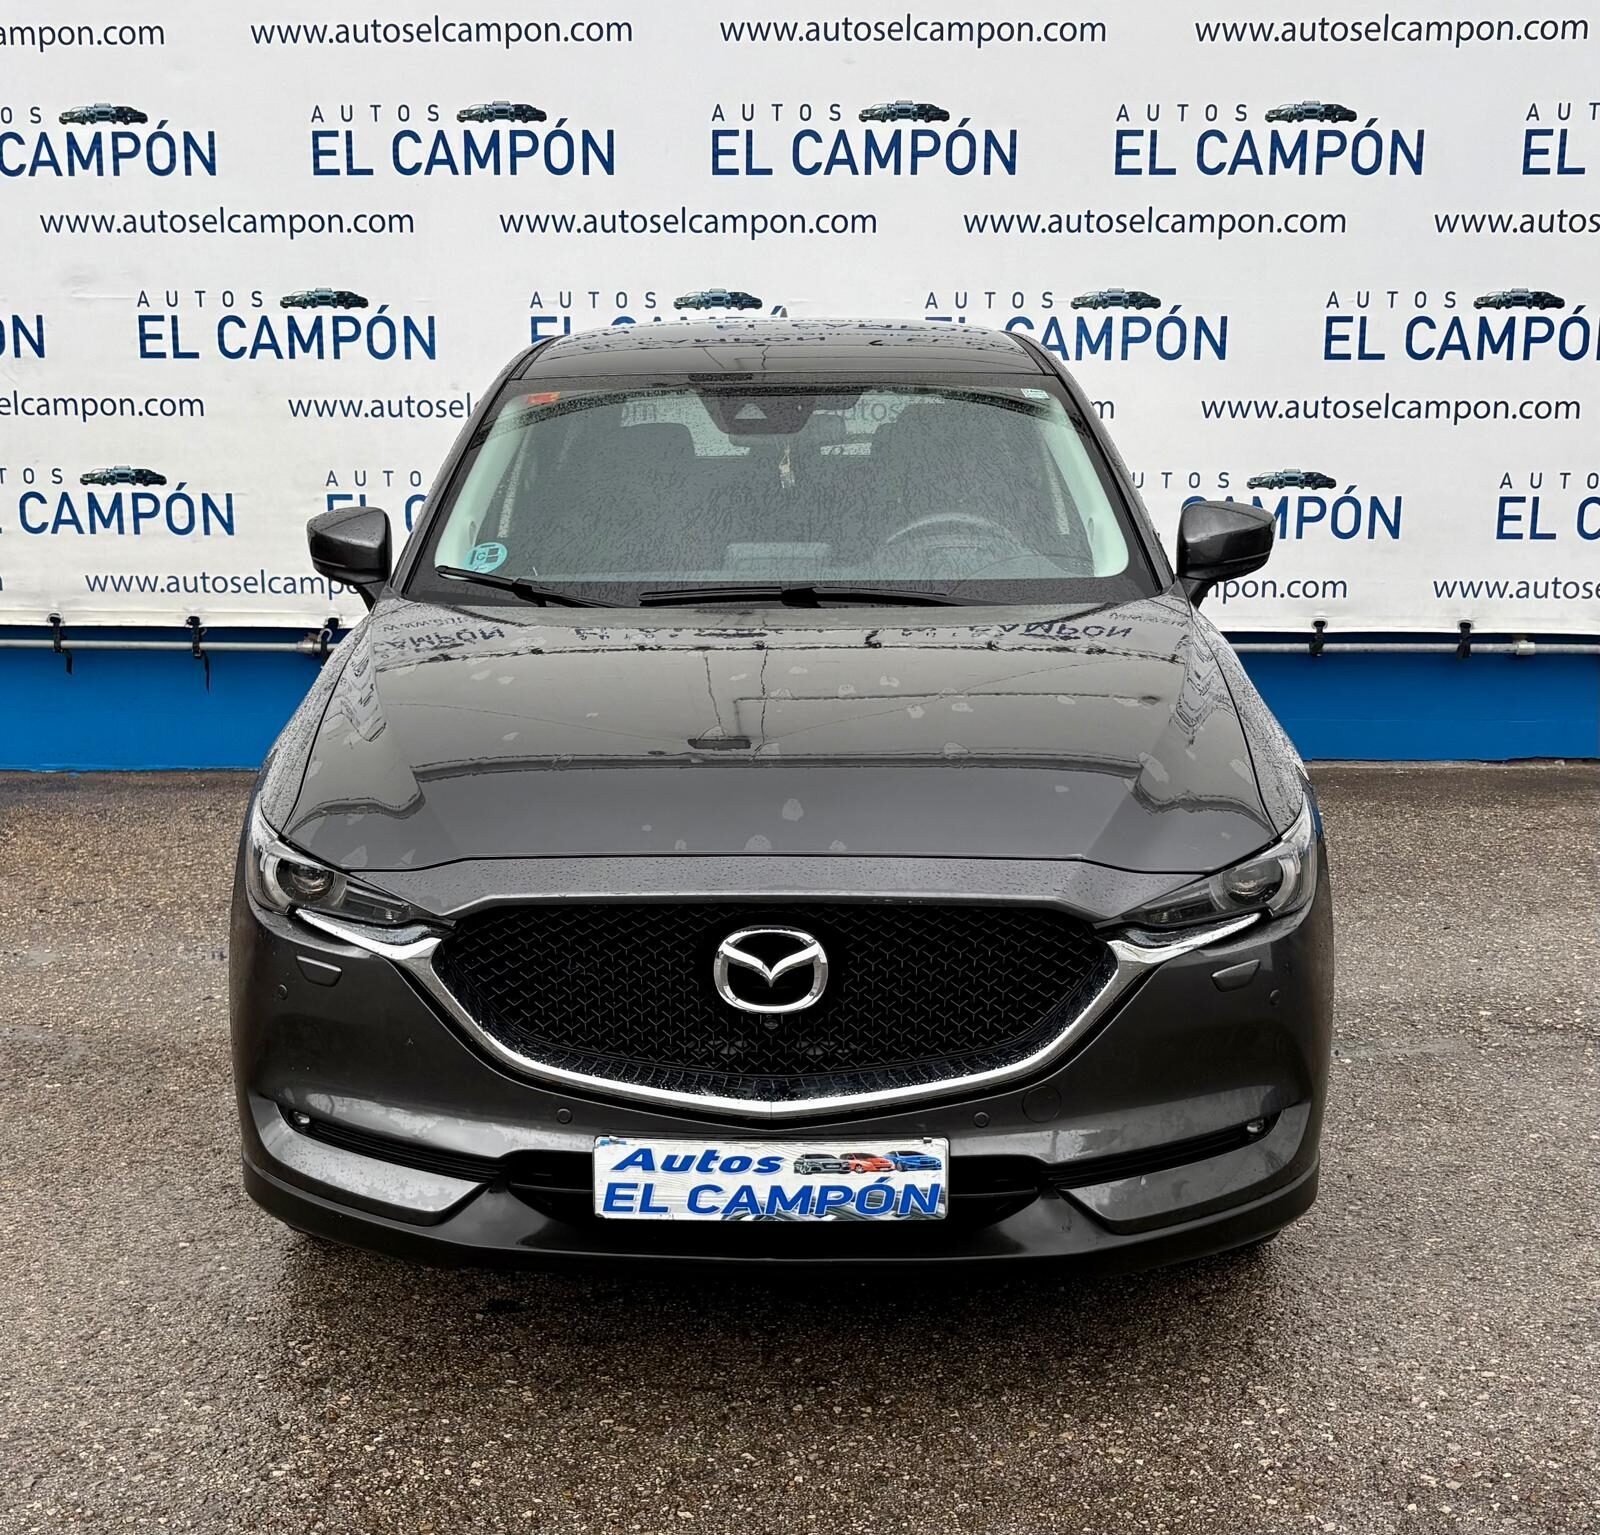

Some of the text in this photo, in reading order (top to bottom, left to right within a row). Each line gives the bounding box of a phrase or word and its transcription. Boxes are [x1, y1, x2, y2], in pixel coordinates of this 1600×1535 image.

[250, 14, 632, 50] www.autoselcampon.com
[719, 13, 1106, 49] www.autoselcampon.com
[1195, 13, 1589, 49] www.autoselcampon.com
[310, 103, 440, 123] AUTOS
[711, 103, 841, 122] AUTOS
[1115, 103, 1247, 122] AUTOS
[0, 118, 217, 178] CAMPÓN
[311, 116, 615, 176] EL CAMPÓN
[711, 116, 1018, 176] EL CAMPÓN
[1114, 116, 1425, 176] EL CAMPÓN
[1522, 128, 1586, 176] EL
[39, 206, 414, 241] www.autoselcampon.com
[499, 206, 877, 241] www.autoselcampon.com
[963, 205, 1346, 241] www.autoselcampon.com
[136, 290, 263, 308] AUTOS
[529, 291, 657, 309] AUTOS
[924, 291, 1054, 309] AUTOS
[1325, 290, 1456, 309] AUTOS
[137, 302, 436, 361] EL CAMPÓN
[1323, 302, 1600, 362] EL CAMPÓ
[0, 389, 205, 423] elcampon.com
[287, 391, 479, 418] www.autosel
[1201, 392, 1581, 426] www.autoselcampon.com
[18, 481, 235, 537] CAMPÓN
[1495, 495, 1557, 540] EL
[612, 1147, 785, 1174] Autos
[602, 1176, 942, 1216] EL CAMPÓN
